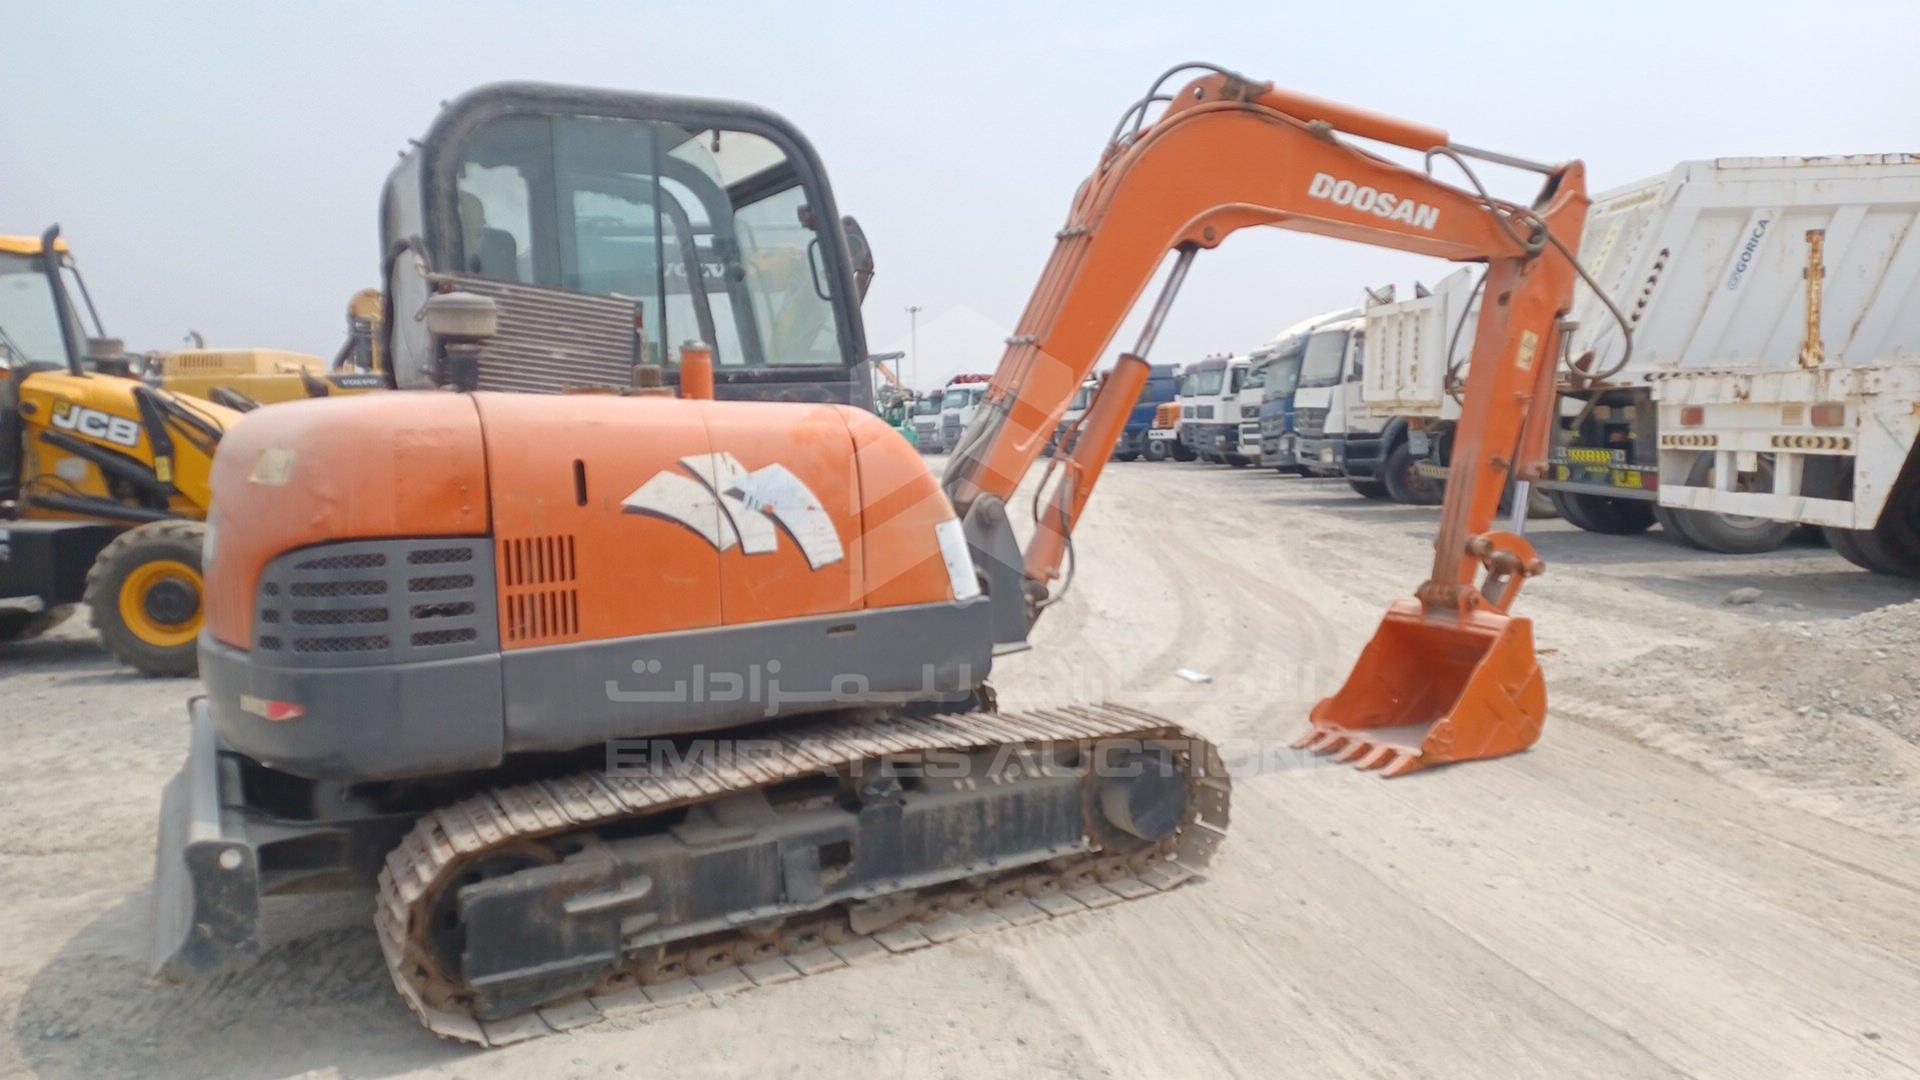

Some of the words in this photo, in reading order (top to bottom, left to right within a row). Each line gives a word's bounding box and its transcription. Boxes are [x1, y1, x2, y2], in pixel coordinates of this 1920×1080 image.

[1307, 172, 1441, 231] DOOSAN
[1735, 219, 1770, 273] GORICA
[51, 405, 139, 447] JCB
